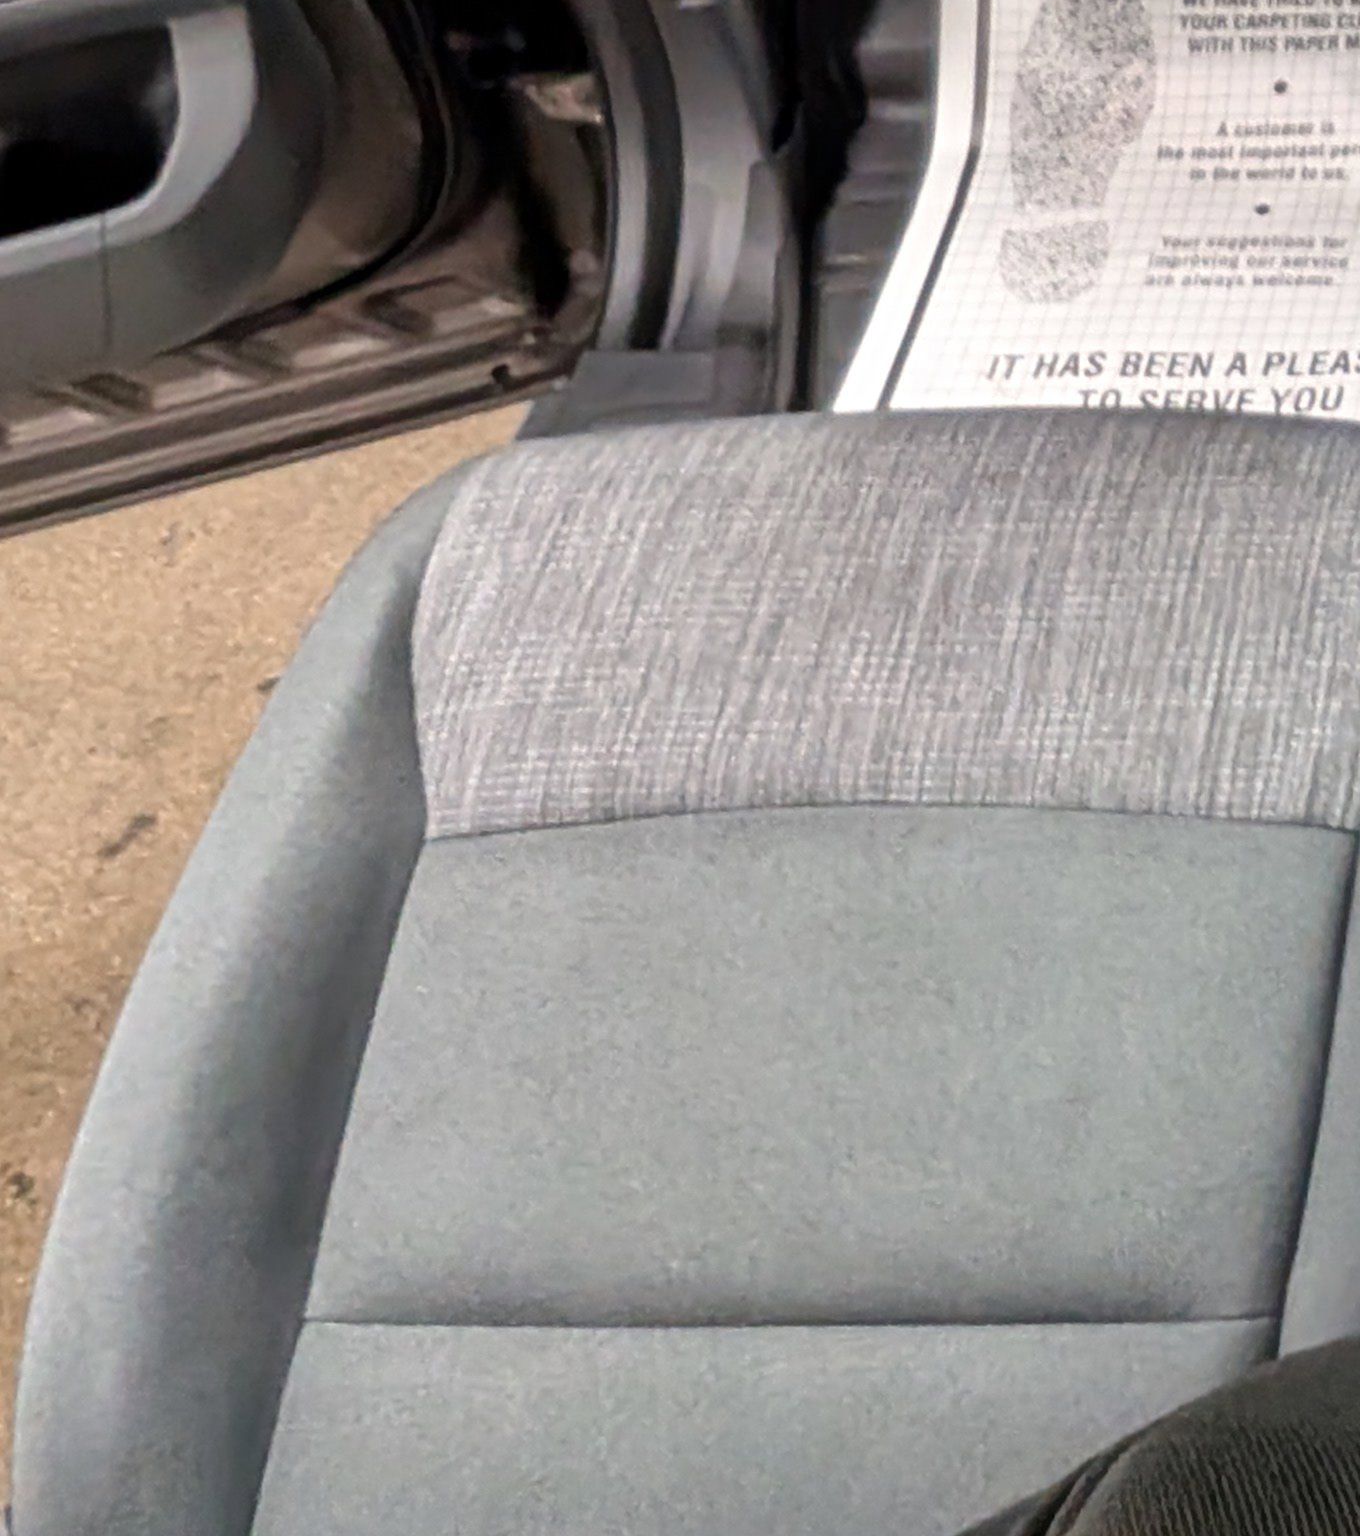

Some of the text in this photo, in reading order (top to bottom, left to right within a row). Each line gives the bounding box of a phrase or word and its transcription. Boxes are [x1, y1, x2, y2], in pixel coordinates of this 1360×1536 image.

[1180, 14, 1228, 30] YOUR
[1234, 13, 1331, 29] CARPETING
[1188, 36, 1234, 53] WITH
[1240, 35, 1277, 52] THIS
[1284, 34, 1339, 50] PAPER
[1216, 122, 1335, 137] A customer is
[1191, 145, 1233, 159] most
[1240, 143, 1324, 160] important
[1246, 167, 1295, 179] world
[1181, 275, 1244, 288] always
[986, 354, 1024, 380] IT
[1032, 351, 1106, 379] HAS
[1118, 350, 1215, 379] BEEN
[1224, 351, 1249, 378] A
[1079, 385, 1345, 415] TO SERVE YOU
